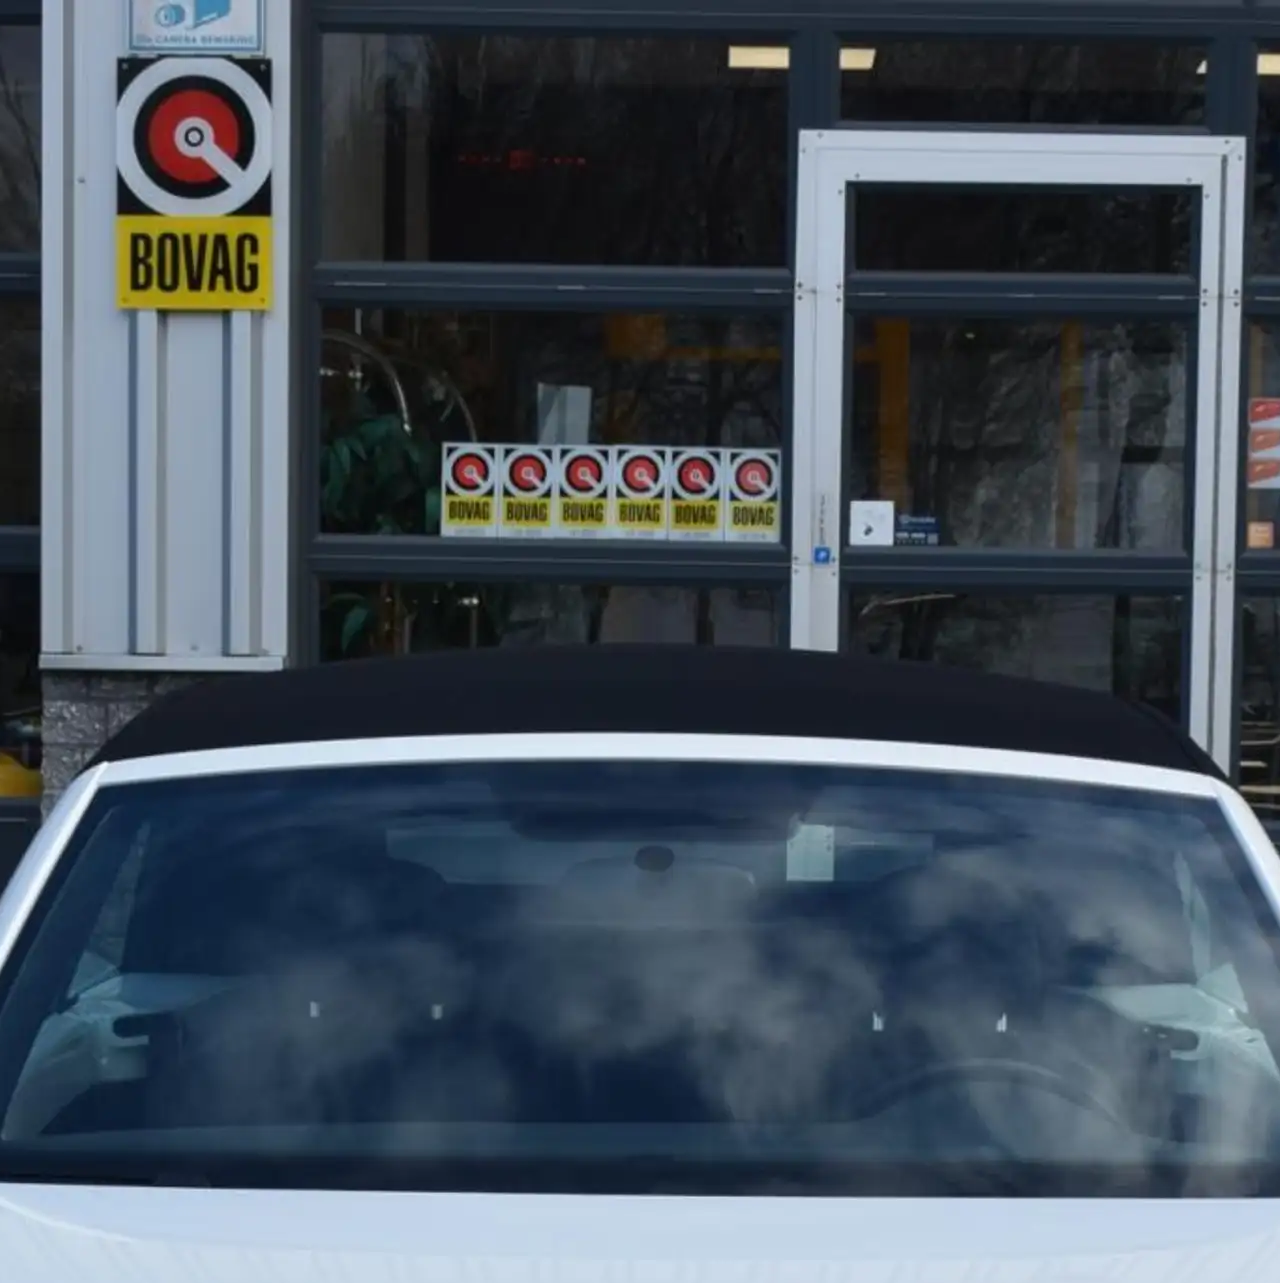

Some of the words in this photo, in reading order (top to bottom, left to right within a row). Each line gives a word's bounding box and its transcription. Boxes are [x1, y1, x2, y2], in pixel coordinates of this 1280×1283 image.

[129, 232, 260, 294] BOVAG
[448, 500, 490, 521] BOVAG
[505, 501, 548, 523] BOVAG
[562, 502, 605, 523] BOVAG
[619, 503, 661, 523] BOVAG
[674, 504, 717, 525] BOVAG
[732, 505, 775, 527] BOVAG
